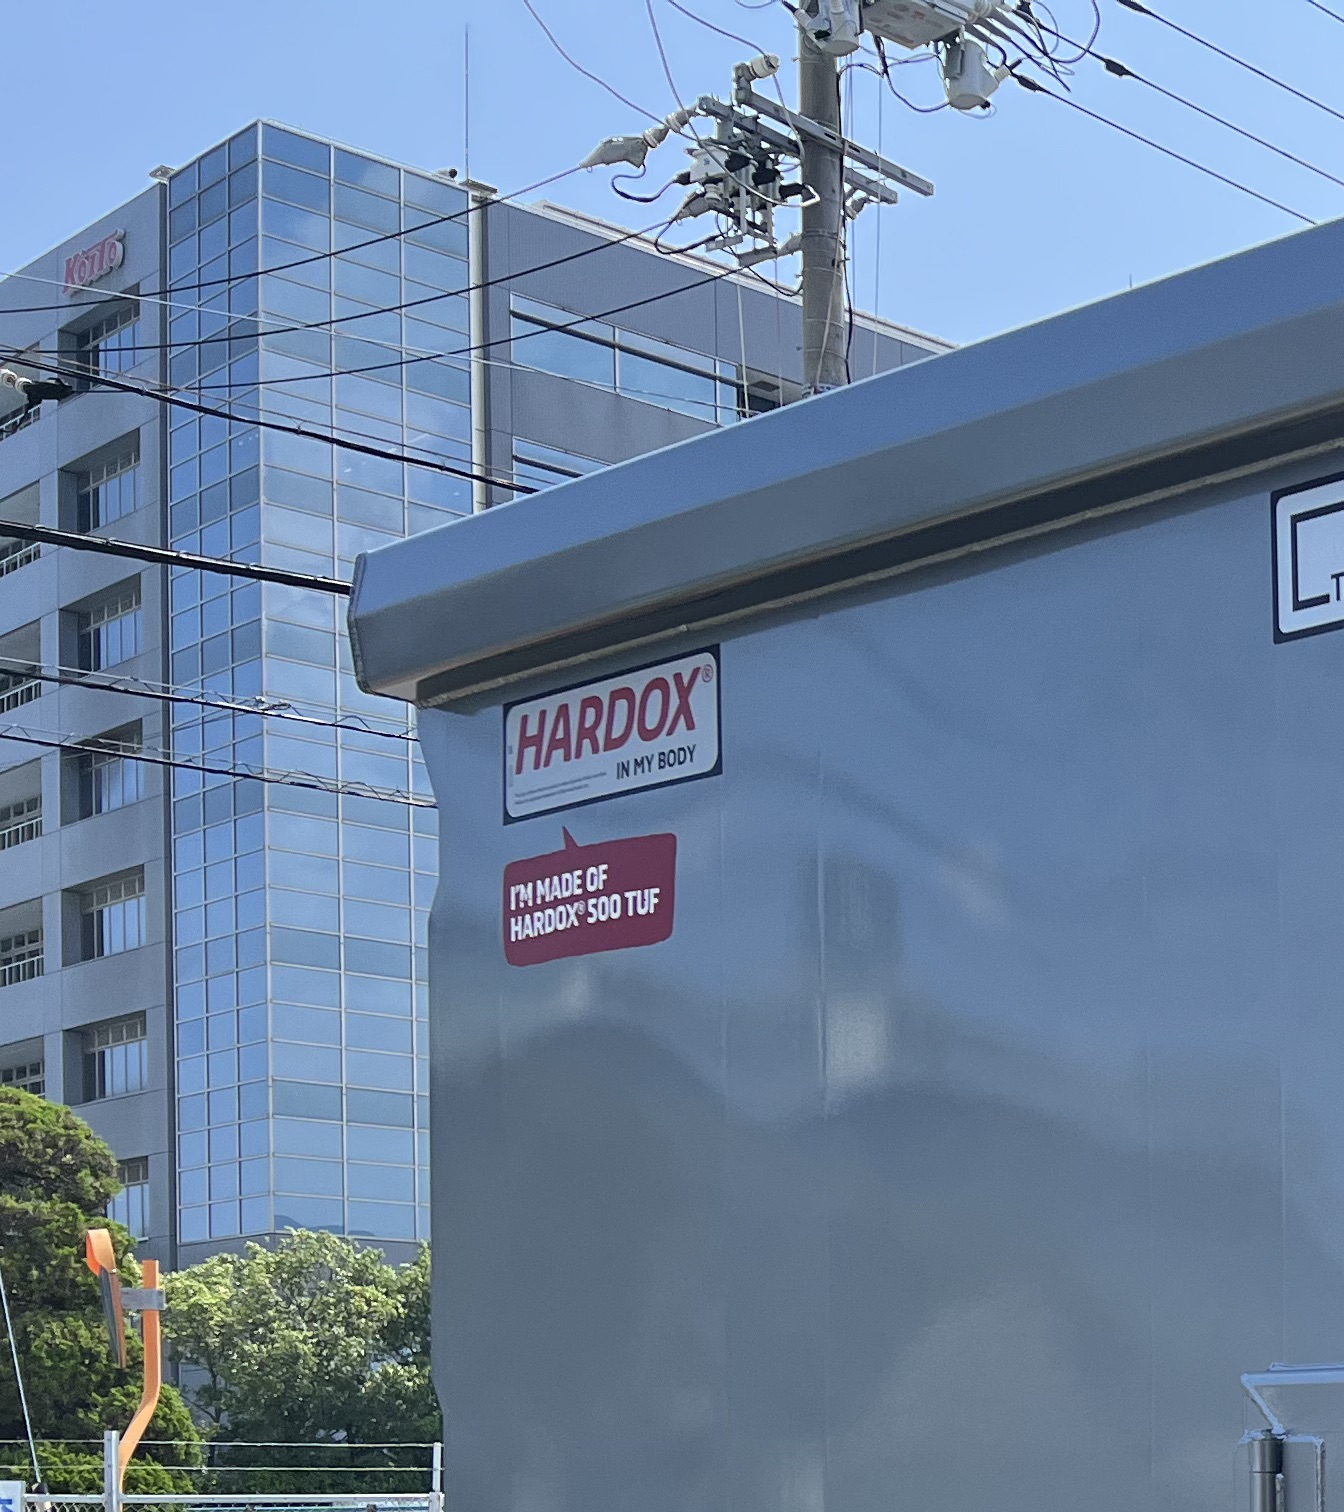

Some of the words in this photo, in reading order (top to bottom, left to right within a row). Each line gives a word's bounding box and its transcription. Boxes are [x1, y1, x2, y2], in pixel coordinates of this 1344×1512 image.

[616, 760, 630, 780] IN
[634, 751, 655, 774] MY
[658, 743, 696, 771] BODY
[510, 881, 533, 911] I'M
[536, 869, 583, 905] MADE
[586, 863, 608, 893] OF
[587, 893, 621, 924] 500
[624, 887, 660, 917] TUF
